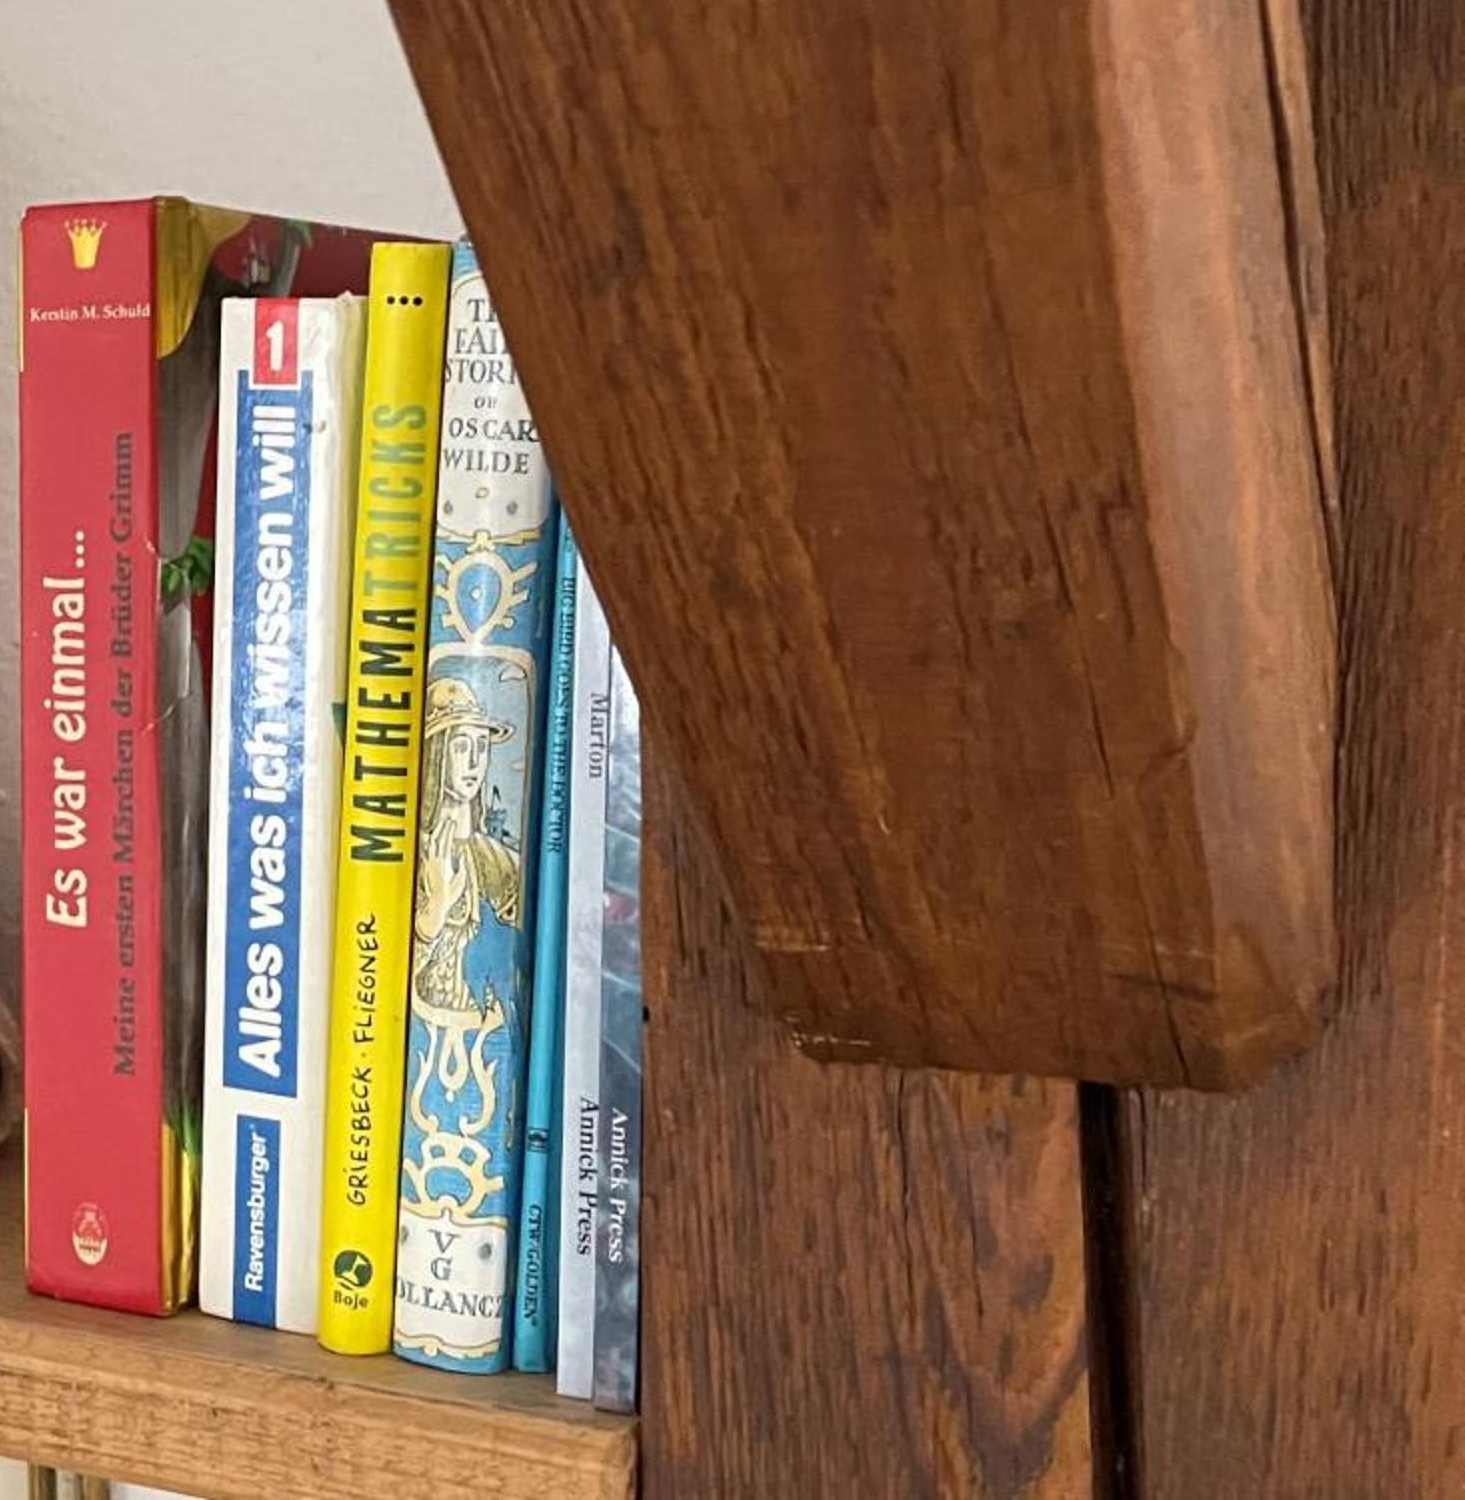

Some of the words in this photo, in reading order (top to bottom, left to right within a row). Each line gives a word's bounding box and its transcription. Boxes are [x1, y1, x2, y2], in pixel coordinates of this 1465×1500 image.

[30, 306, 78, 323] Kerstin
[81, 304, 100, 319] M.
[266, 319, 284, 372] 1
[252, 405, 296, 501] will
[443, 448, 531, 476] WILDE
[448, 416, 539, 443] OSCAR
[109, 431, 133, 544] Grimm
[110, 551, 133, 658] Brüder
[246, 511, 294, 710] wissen
[350, 403, 428, 863] MATHEMATRICKS
[111, 668, 134, 718] der
[589, 692, 609, 779] Marton
[53, 756, 87, 850] war
[111, 728, 135, 864] Märchen
[243, 719, 289, 803] ich
[45, 868, 88, 928] Es
[248, 814, 288, 930] was
[113, 874, 135, 968] ersten
[112, 976, 136, 1077] Meine
[238, 943, 284, 1078] Alles
[579, 1096, 600, 1183] Annick
[608, 1107, 630, 1190] Annick
[244, 1128, 271, 1293] Ravensburger
[428, 1229, 461, 1254] V
[576, 1191, 599, 1256] Press
[608, 1198, 627, 1264] Press
[334, 1290, 369, 1310] Boje
[431, 1256, 454, 1282] G
